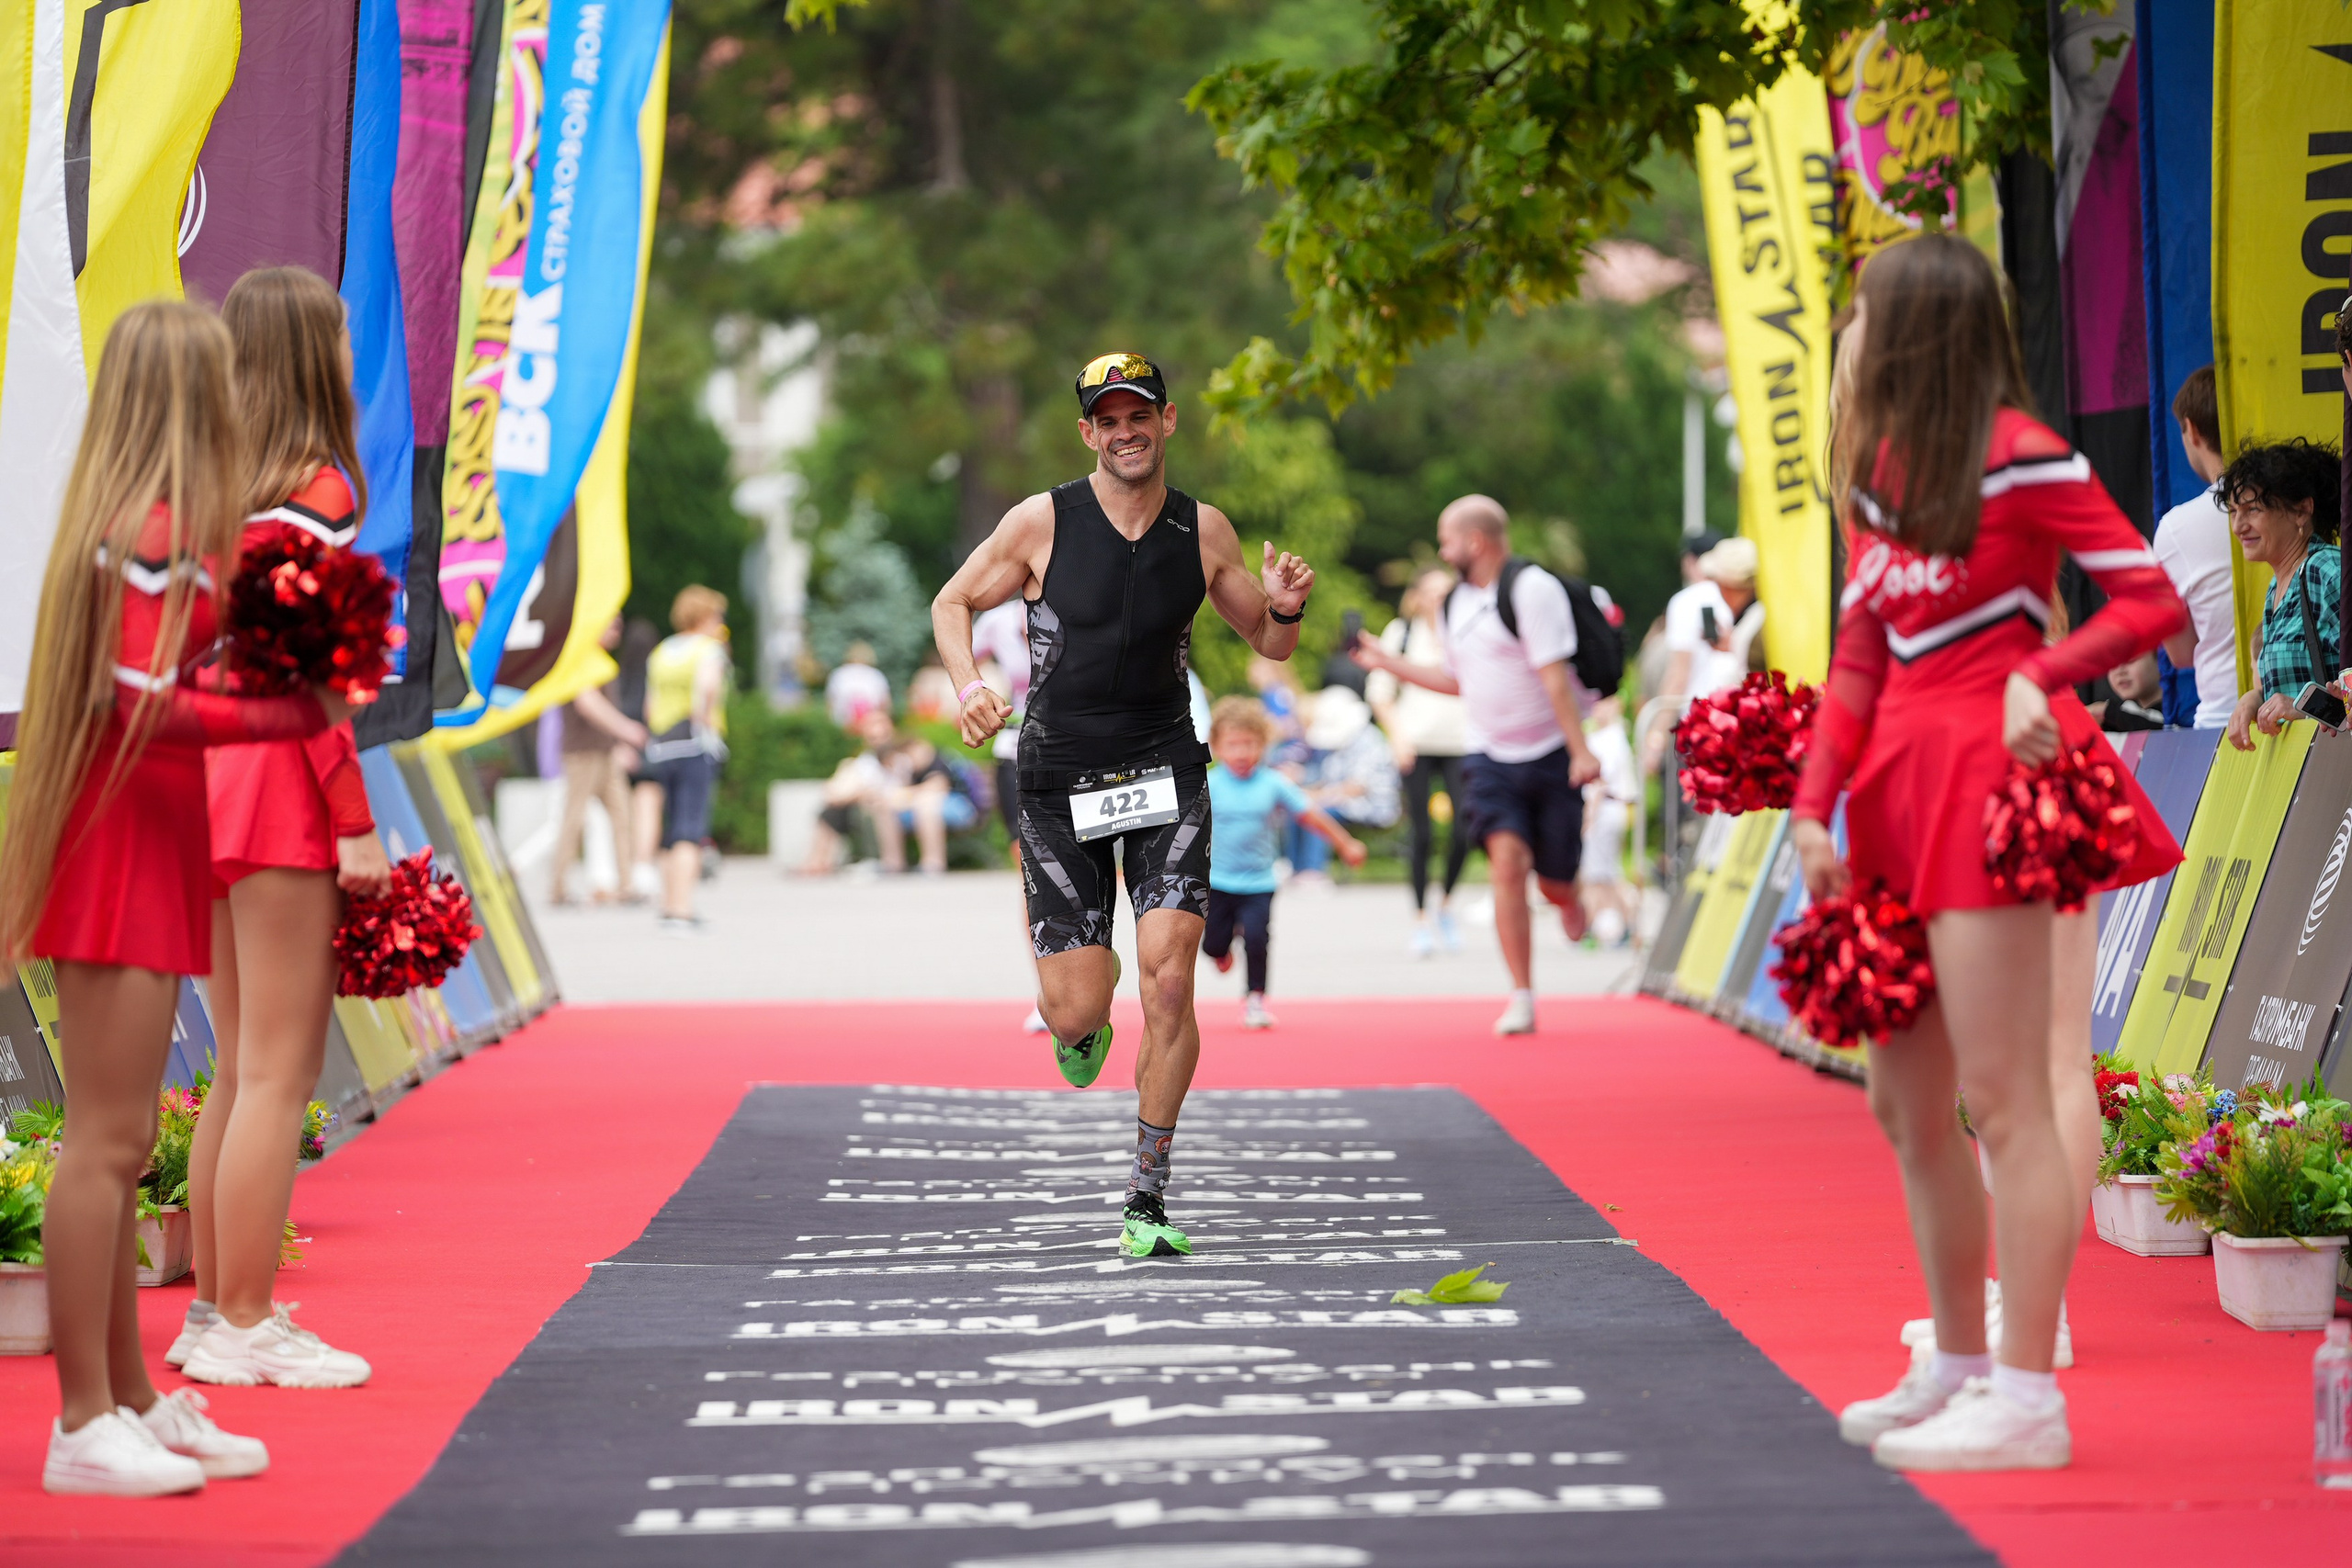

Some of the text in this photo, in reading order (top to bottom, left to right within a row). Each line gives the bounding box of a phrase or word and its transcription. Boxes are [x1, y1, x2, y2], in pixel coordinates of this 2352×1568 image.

[492, 281, 563, 477] ВСК
[539, 88, 593, 282] СТРАХОВОЙ
[570, 3, 606, 85] ДОМ
[1765, 360, 1804, 515] IRON
[1166, 518, 1191, 533] orca
[1099, 788, 1149, 818] 422
[1111, 817, 1142, 830] AGUSTIN
[824, 1190, 1425, 1201] IRON STAR
[789, 1228, 1449, 1258] IRON STAR
[770, 1249, 1464, 1277] IRON STAR
[741, 1308, 1519, 1335] IRON STAR
[696, 1385, 1588, 1418] IRON STAR
[634, 1501, 1034, 1531] IRON
